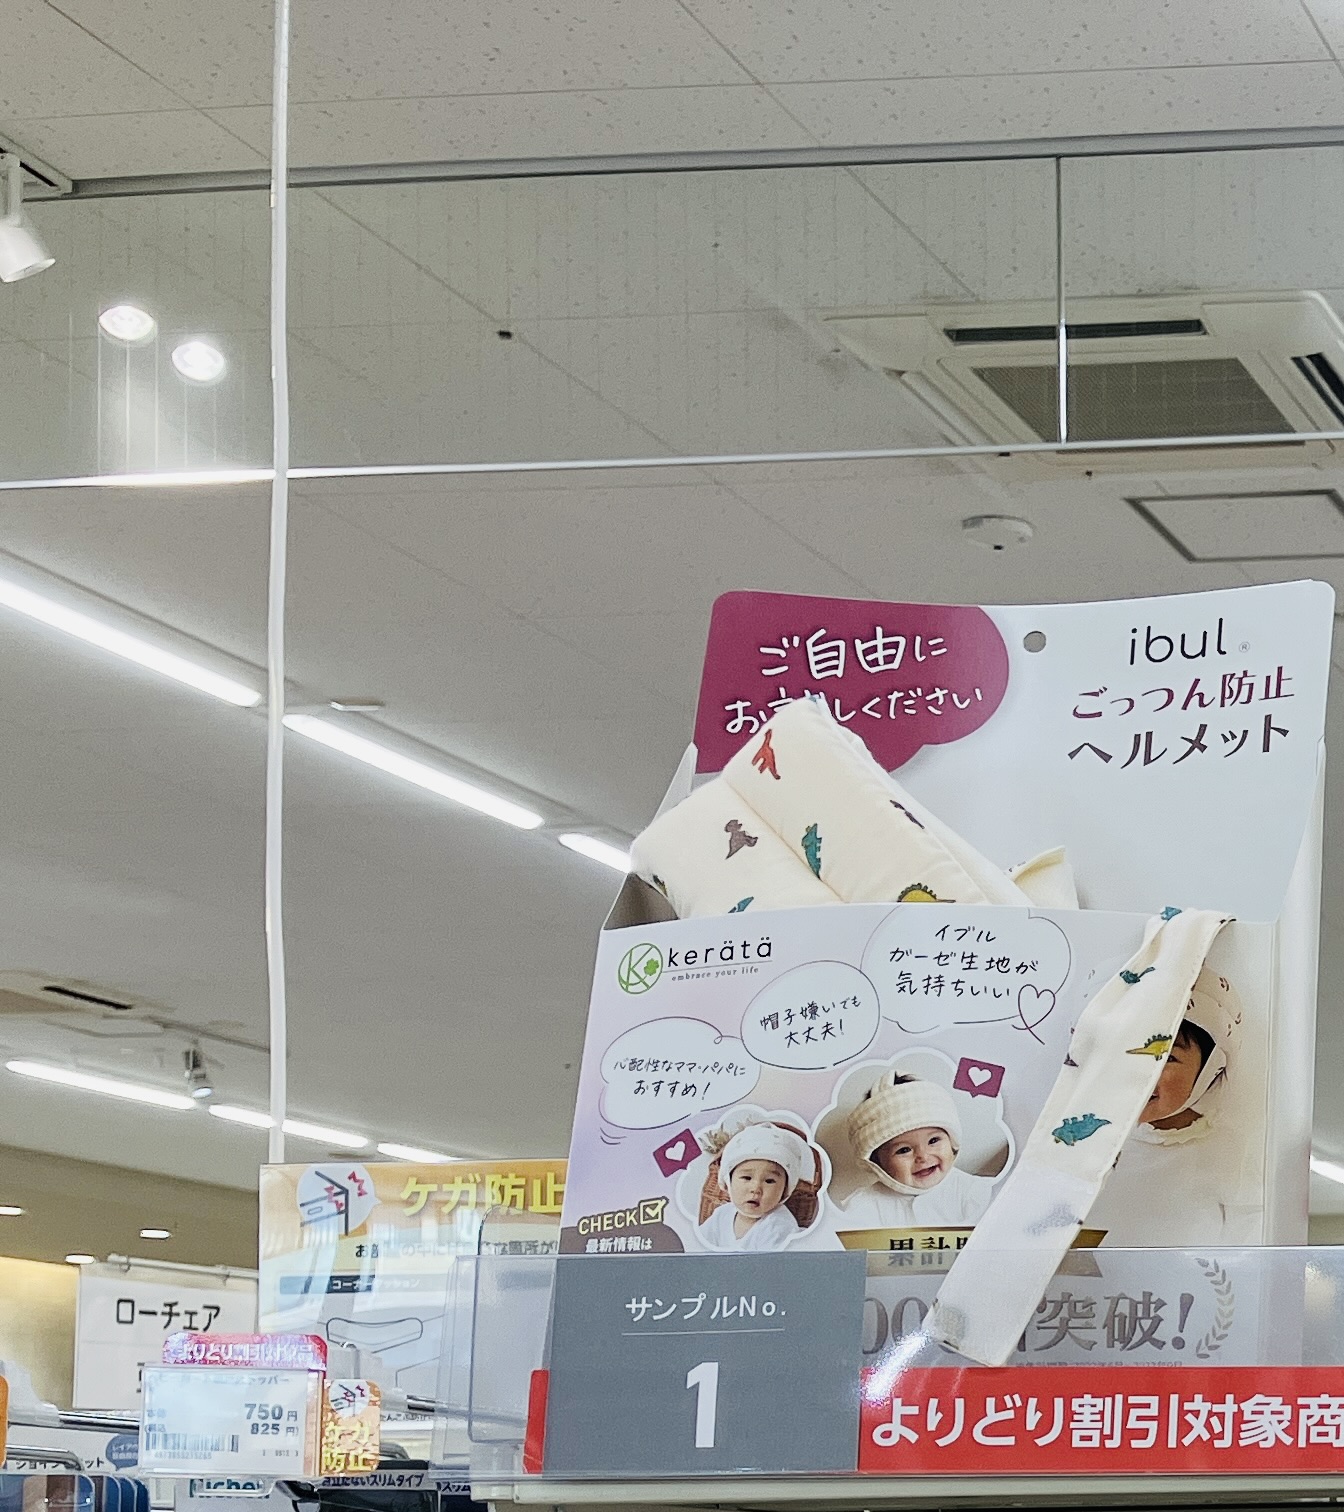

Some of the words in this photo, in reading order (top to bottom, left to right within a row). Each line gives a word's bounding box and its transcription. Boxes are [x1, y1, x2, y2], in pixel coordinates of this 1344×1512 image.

[759, 625, 948, 680] ご自由に
[1128, 618, 1228, 666] ibul
[1072, 666, 1295, 720] ごっつん防止
[1067, 715, 1290, 769] ヘルメット
[935, 924, 997, 944] イブル
[668, 938, 772, 969] kerätä
[890, 947, 1039, 974] ガーゼ生地が
[896, 971, 1011, 1000] 気持ちいい
[760, 996, 862, 1031] 帽子嫌いでも
[400, 1172, 564, 1216] ケガ防止
[578, 1210, 639, 1238] CHECK
[586, 1236, 652, 1253] 最新情報は
[117, 1298, 221, 1330] ローチェア
[624, 1294, 788, 1324] サンプルNo.
[245, 1403, 283, 1420] 750
[685, 1362, 719, 1449] 1
[250, 1423, 280, 1435] 825
